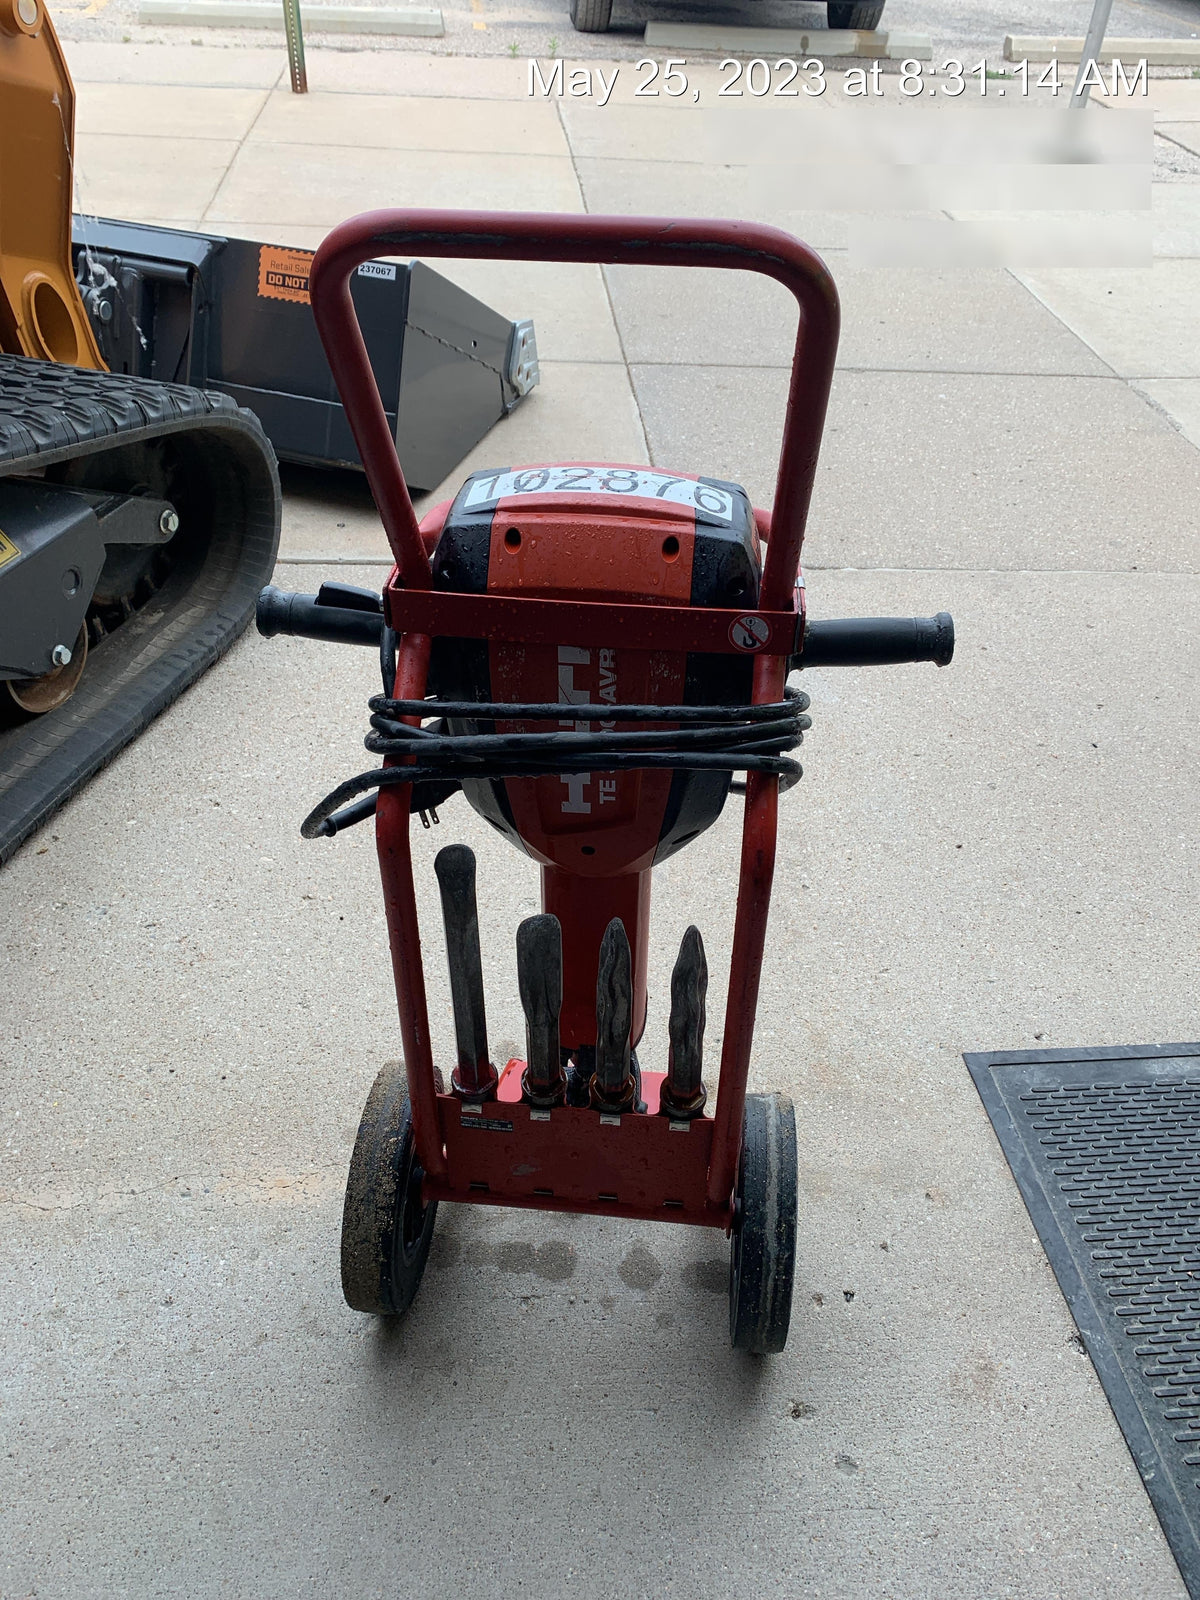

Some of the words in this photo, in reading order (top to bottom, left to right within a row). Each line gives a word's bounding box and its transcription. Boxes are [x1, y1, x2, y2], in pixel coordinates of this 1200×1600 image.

[270, 260, 293, 271] Retail
[360, 264, 391, 276] 237067
[268, 273, 283, 285] DO
[284, 276, 307, 289] NOT
[478, 467, 728, 514] 102876
[600, 779, 616, 804] TE
